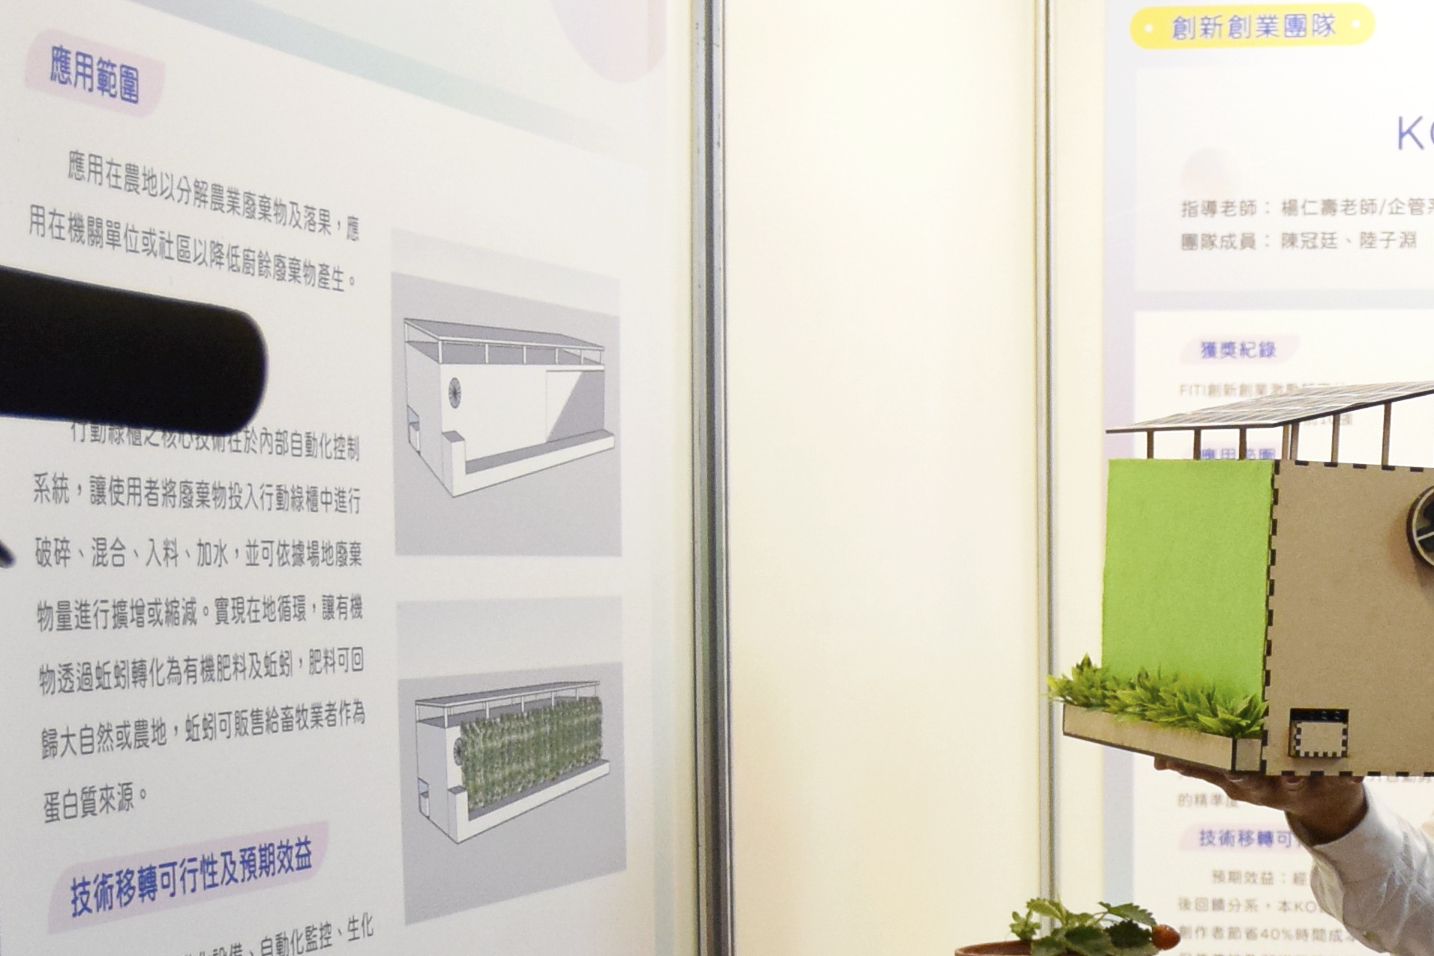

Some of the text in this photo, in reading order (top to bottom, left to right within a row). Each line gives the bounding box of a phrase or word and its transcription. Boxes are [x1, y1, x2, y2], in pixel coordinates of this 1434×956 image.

[1172, 13, 1337, 41] 創新創業團隊
[50, 45, 140, 105] 應用範圍
[44, 781, 147, 824] 蛋白質來源。
[1199, 830, 1304, 848] 技術移轉可
[70, 835, 313, 917] 技術移轉可行性及預期效益
